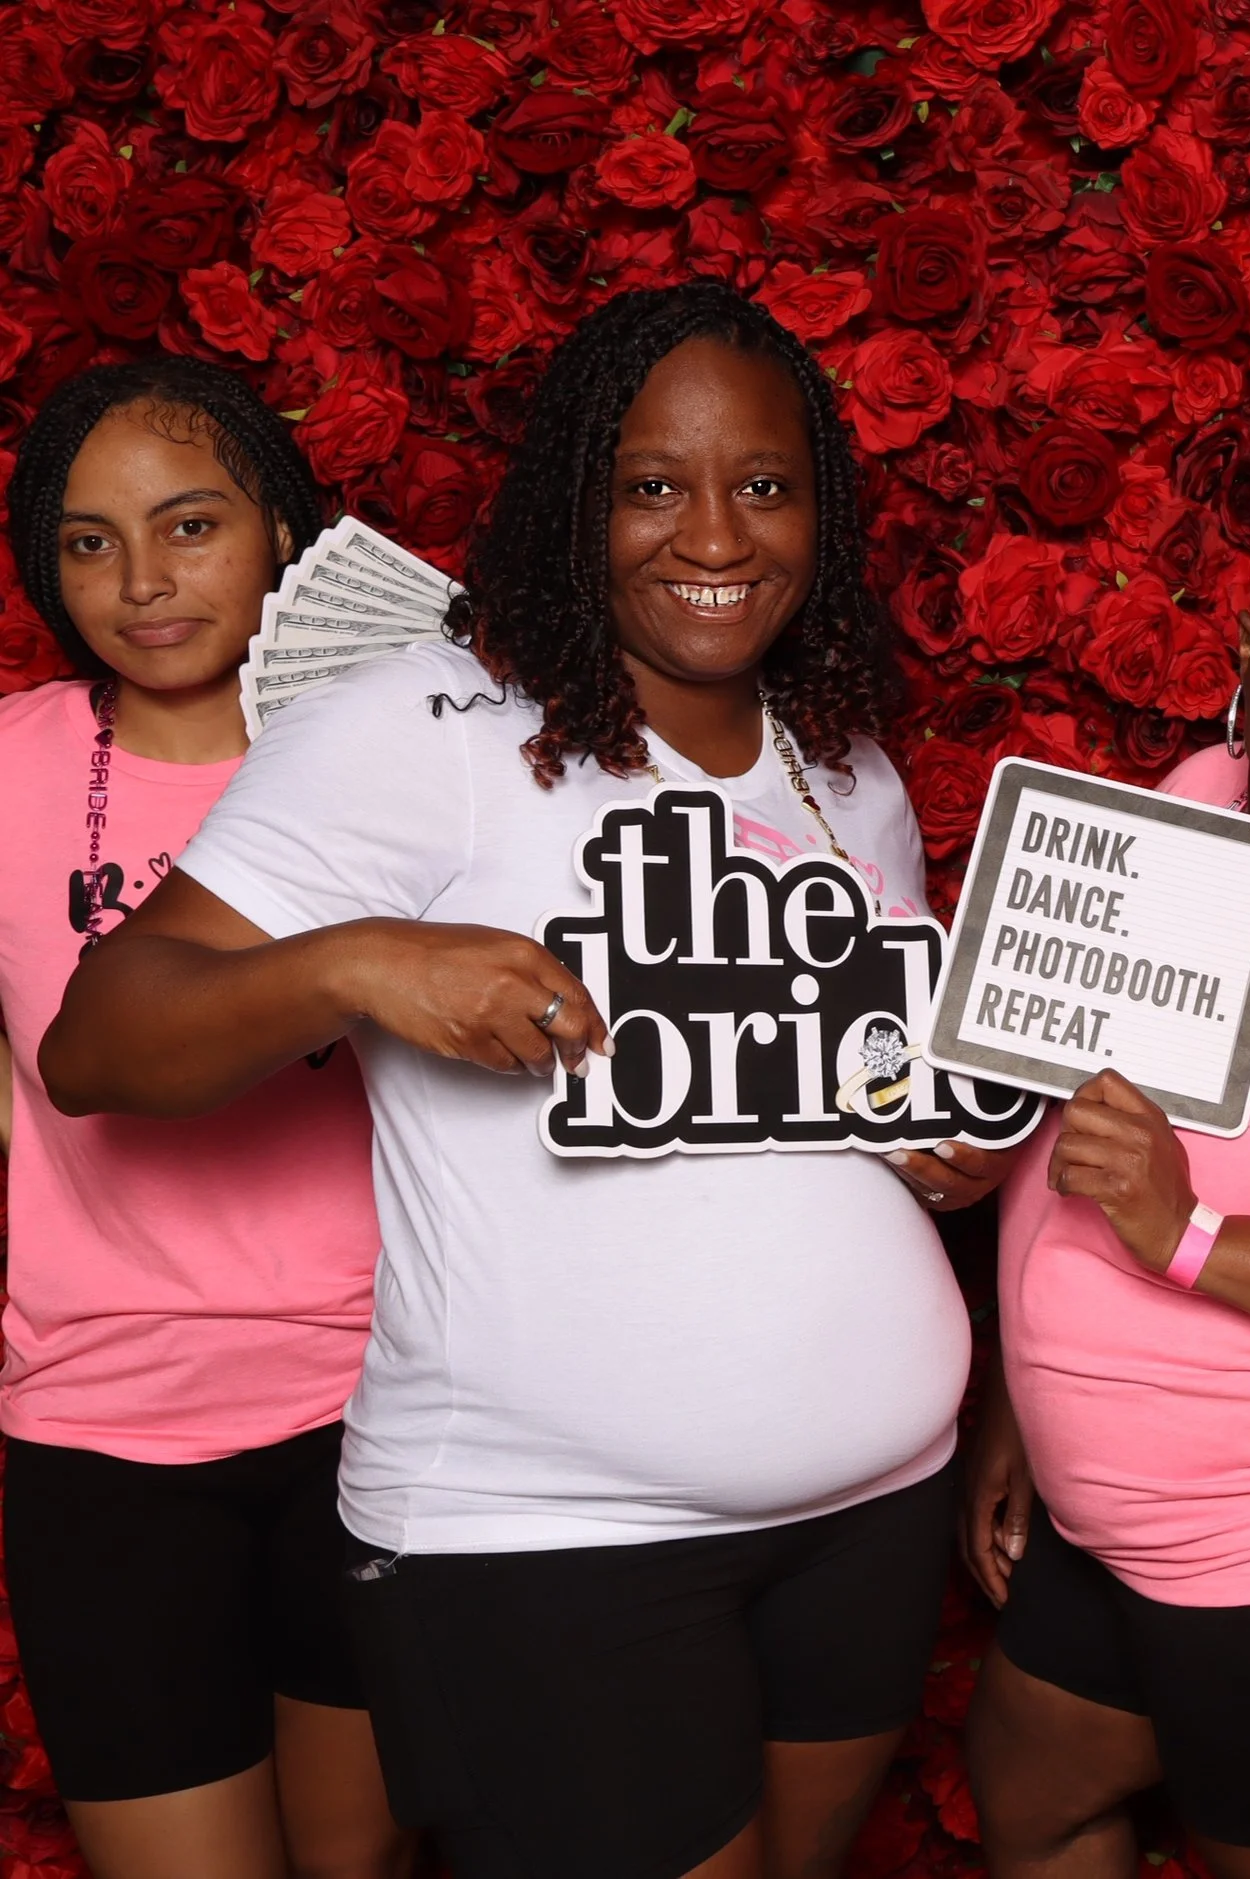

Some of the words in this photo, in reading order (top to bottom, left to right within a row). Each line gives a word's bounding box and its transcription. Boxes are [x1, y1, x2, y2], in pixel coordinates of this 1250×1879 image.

[86, 751, 112, 830] BRIDE
[1021, 810, 1139, 880] DRINK.
[601, 806, 856, 969] the
[1006, 867, 1129, 937] DANCE.
[991, 924, 1226, 1022] PHOTOBOOTH.
[975, 982, 1113, 1057] REPEAT.
